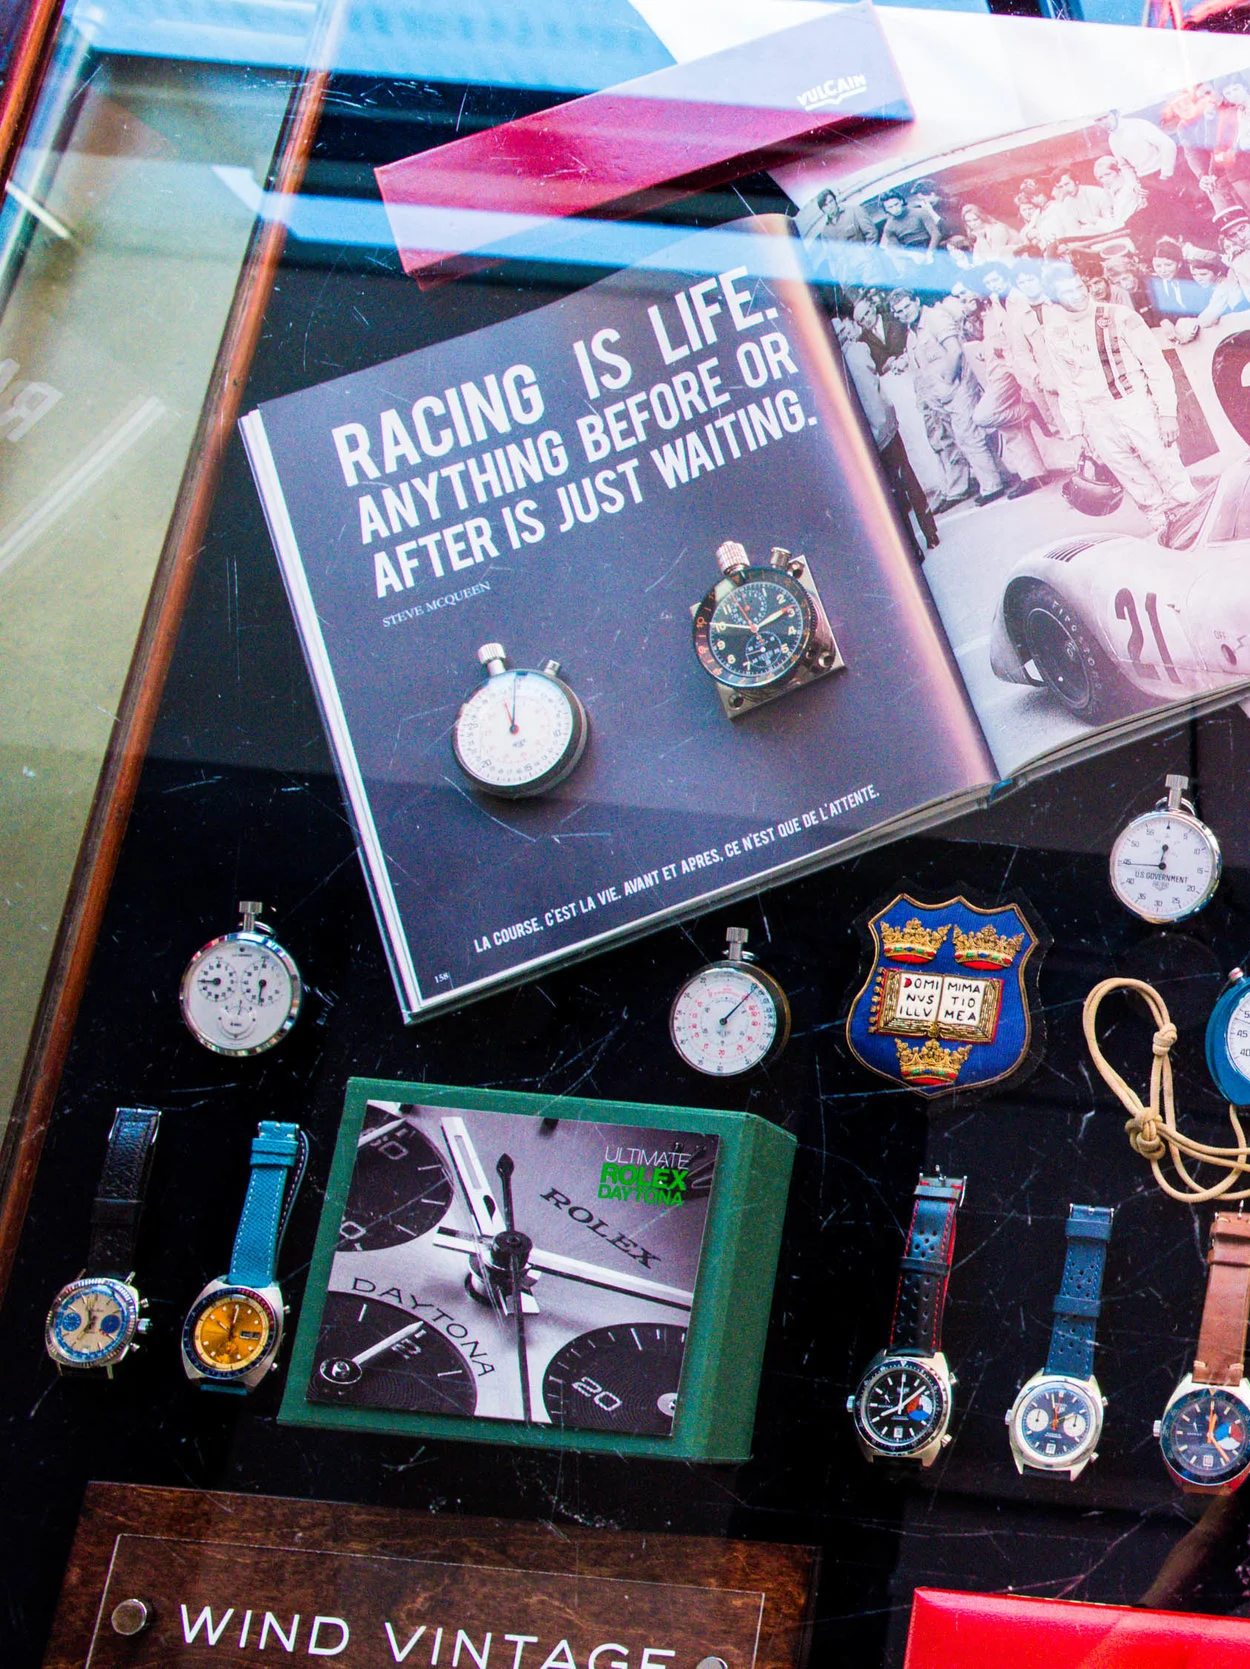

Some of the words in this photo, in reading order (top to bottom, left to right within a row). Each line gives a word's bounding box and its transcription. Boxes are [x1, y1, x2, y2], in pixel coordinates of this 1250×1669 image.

[796, 74, 866, 106] VULCAIN
[331, 363, 546, 487] RACING
[573, 327, 632, 399] IS
[647, 265, 779, 365] LIFE.
[357, 429, 568, 544] ANYTHING
[577, 358, 731, 464] BEFORE
[736, 332, 799, 389] OR
[372, 525, 501, 599] AFTER
[502, 498, 546, 550] IS
[559, 462, 643, 533] JUST
[651, 388, 818, 491] WAITING.
[382, 605, 424, 627] STEVE
[425, 581, 491, 612] MCQUEEN
[787, 607, 795, 618] 3
[788, 626, 796, 636] 4
[1115, 588, 1182, 684] 21
[473, 936, 492, 953] LA
[493, 917, 544, 946] COURSE,
[544, 903, 578, 927] C'EST
[579, 896, 596, 914] LA
[597, 887, 622, 906] VIE.
[623, 870, 660, 897] AVANT
[661, 863, 678, 881] ET
[681, 849, 724, 875] APRES,
[724, 840, 741, 858] CE
[742, 827, 776, 851] N'EST
[777, 817, 802, 838] QUE
[802, 810, 819, 828] DE
[818, 784, 880, 821] L'ATTENTE.
[1146, 872, 1188, 883] GOVERNMENT
[434, 972, 449, 983] 158
[903, 977, 939, 990] DOMI
[899, 1006, 932, 1017] ILLV
[907, 994, 934, 1005] NVS
[952, 996, 976, 1008] TIO
[944, 1009, 976, 1021] MEA
[605, 1145, 692, 1170] ULTIMATE
[600, 1162, 689, 1192] ROLEX
[598, 1183, 683, 1207] DAYTONA
[540, 1187, 662, 1270] ROLEX
[351, 1277, 496, 1378] DAYTONA
[572, 1375, 622, 1412] 20
[180, 1603, 350, 1656] WIND
[384, 1622, 676, 1669] VINTAGE
